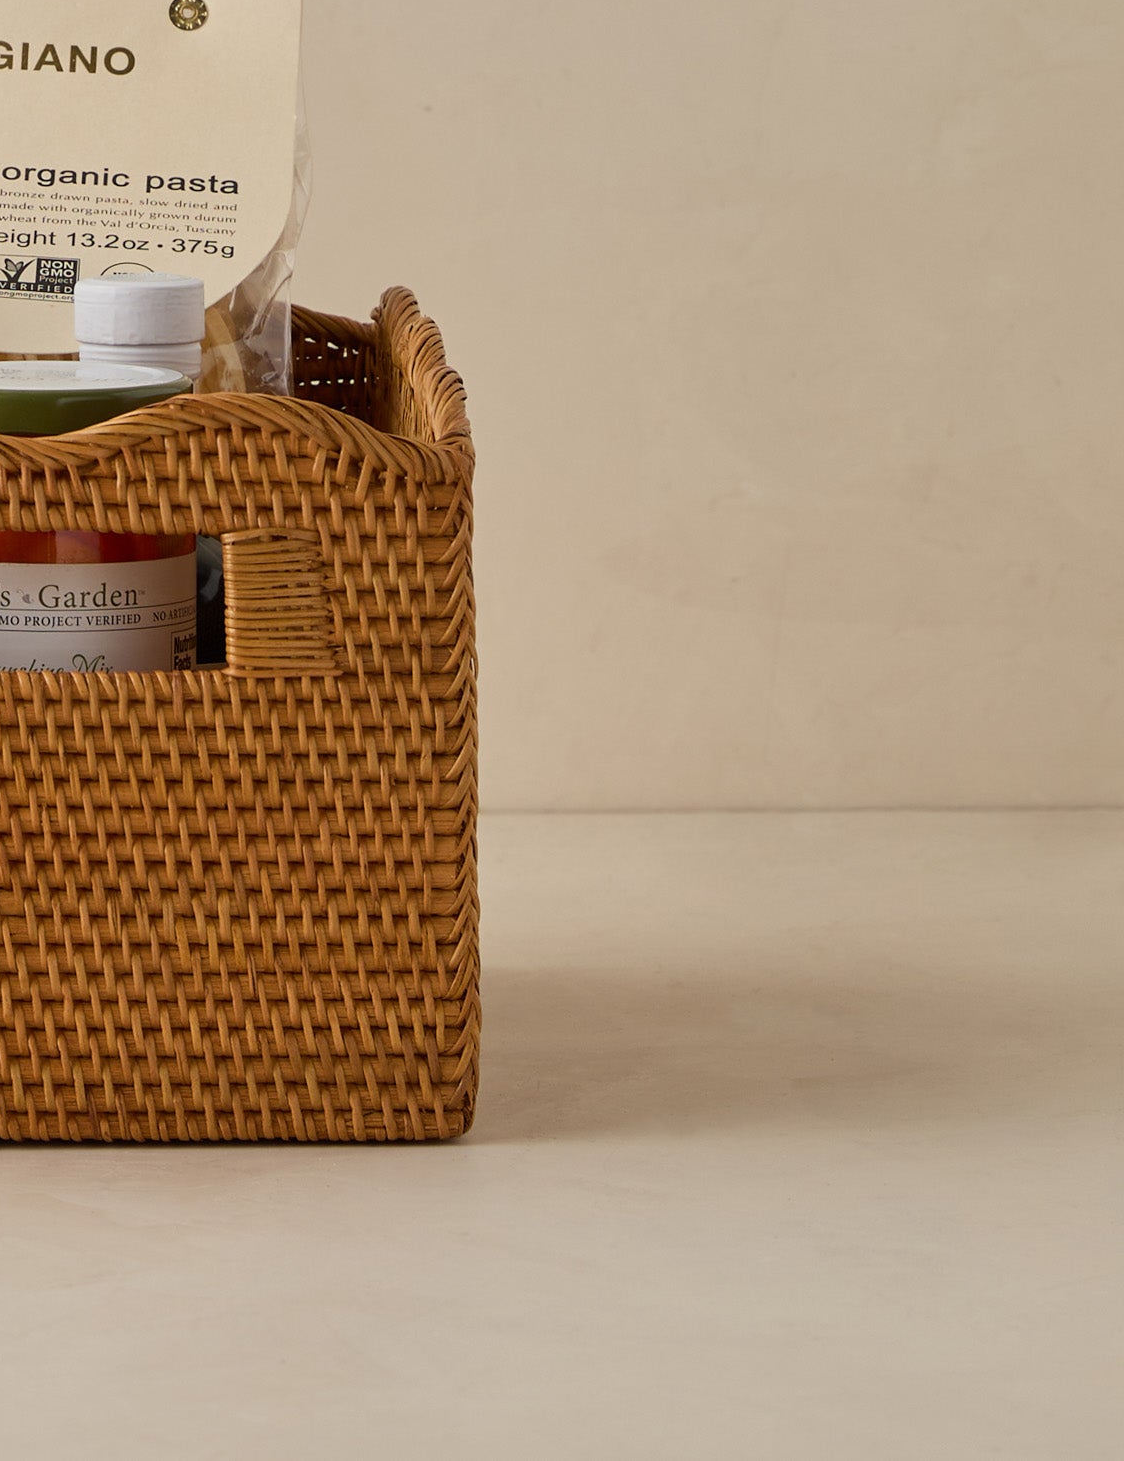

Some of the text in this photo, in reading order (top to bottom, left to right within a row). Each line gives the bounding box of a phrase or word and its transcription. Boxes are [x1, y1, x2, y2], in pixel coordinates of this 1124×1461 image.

[1, 165, 239, 194] organic pasta
[0, 189, 238, 212] bronze drawn pasta, slow dried and
[0, 201, 237, 224] made with organically grown durum
[41, 215, 72, 225] from
[76, 217, 97, 227] the
[100, 219, 121, 228] Val
[184, 225, 237, 236] Tuscany
[66, 232, 150, 251] 13.2oz
[171, 238, 235, 259] 375g
[39, 259, 75, 270] NON
[39, 267, 75, 278] GMO
[39, 275, 74, 285] Project
[0, 281, 74, 294] VERIFIED
[24, 616, 82, 628] PROJECT
[86, 613, 141, 626] VERIFIED
[153, 611, 166, 622] NO
